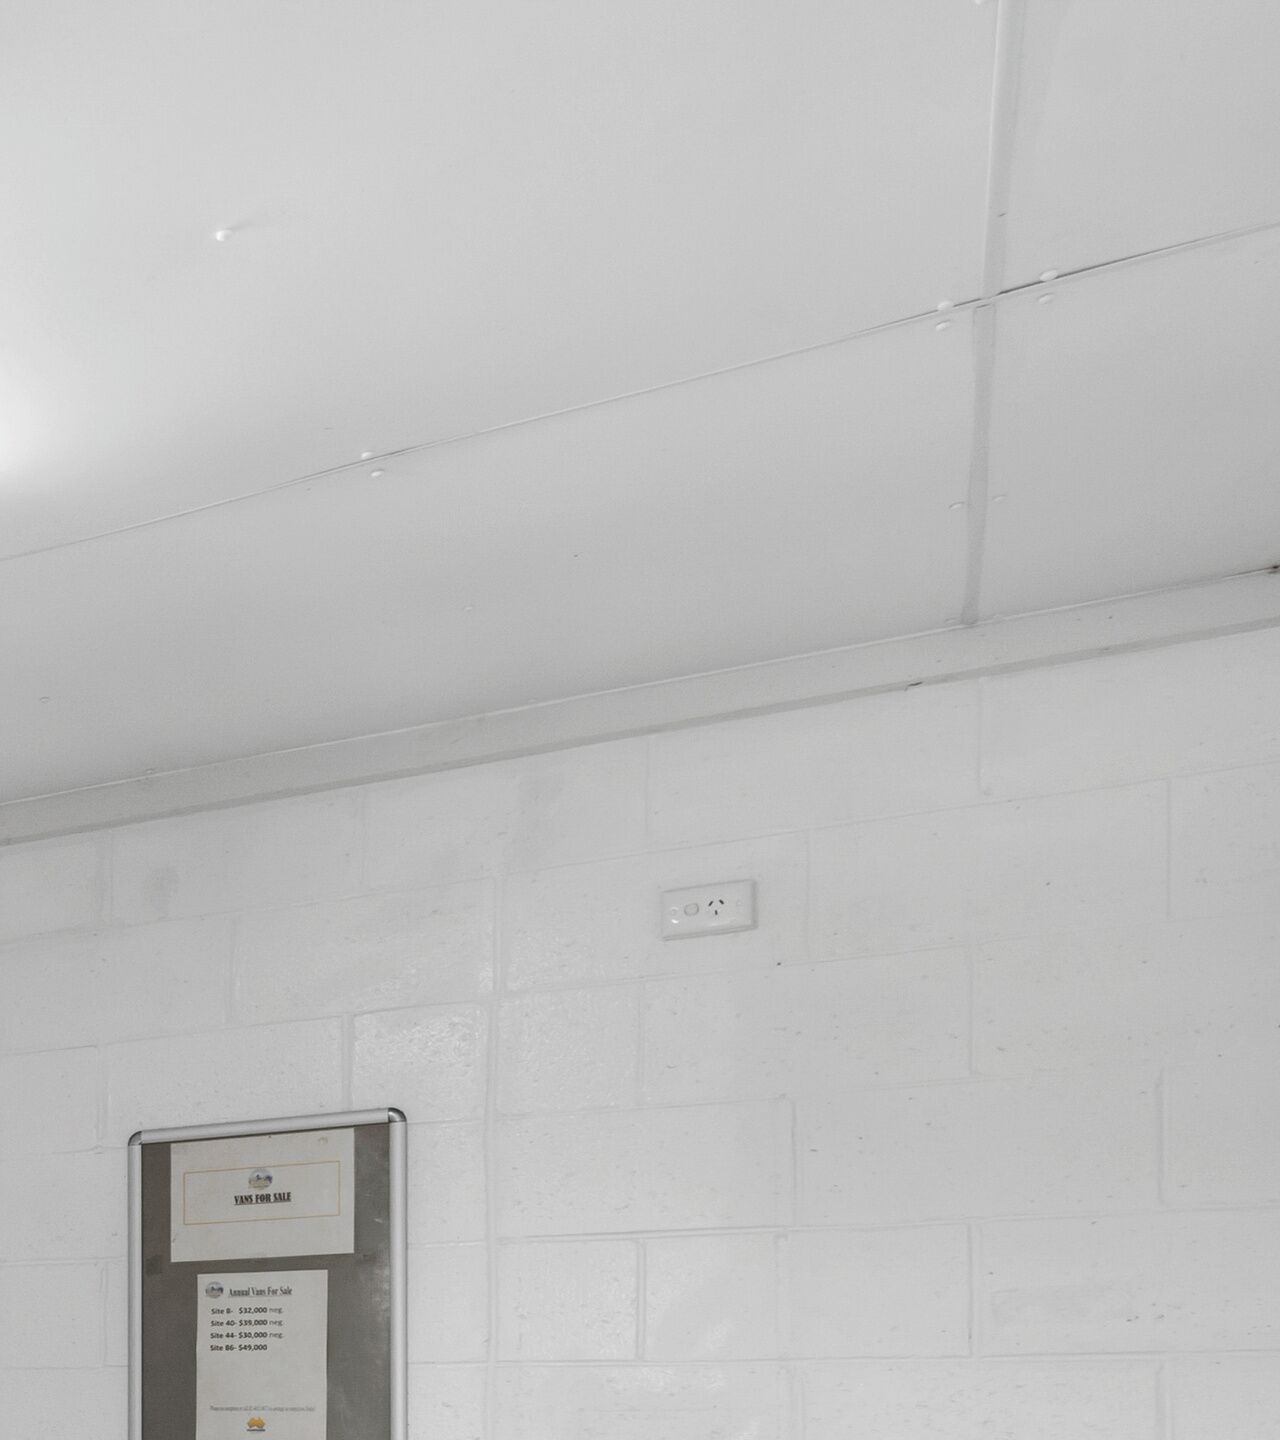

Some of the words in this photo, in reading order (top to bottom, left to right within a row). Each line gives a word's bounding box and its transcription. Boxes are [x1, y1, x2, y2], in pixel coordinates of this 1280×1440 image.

[234, 1195, 253, 1205] VANS
[256, 1193, 271, 1204] FOR
[273, 1192, 291, 1202] SALE
[229, 1287, 250, 1296] Annual
[251, 1287, 266, 1296] Vans
[268, 1286, 278, 1295] For
[280, 1286, 292, 1296] Sale
